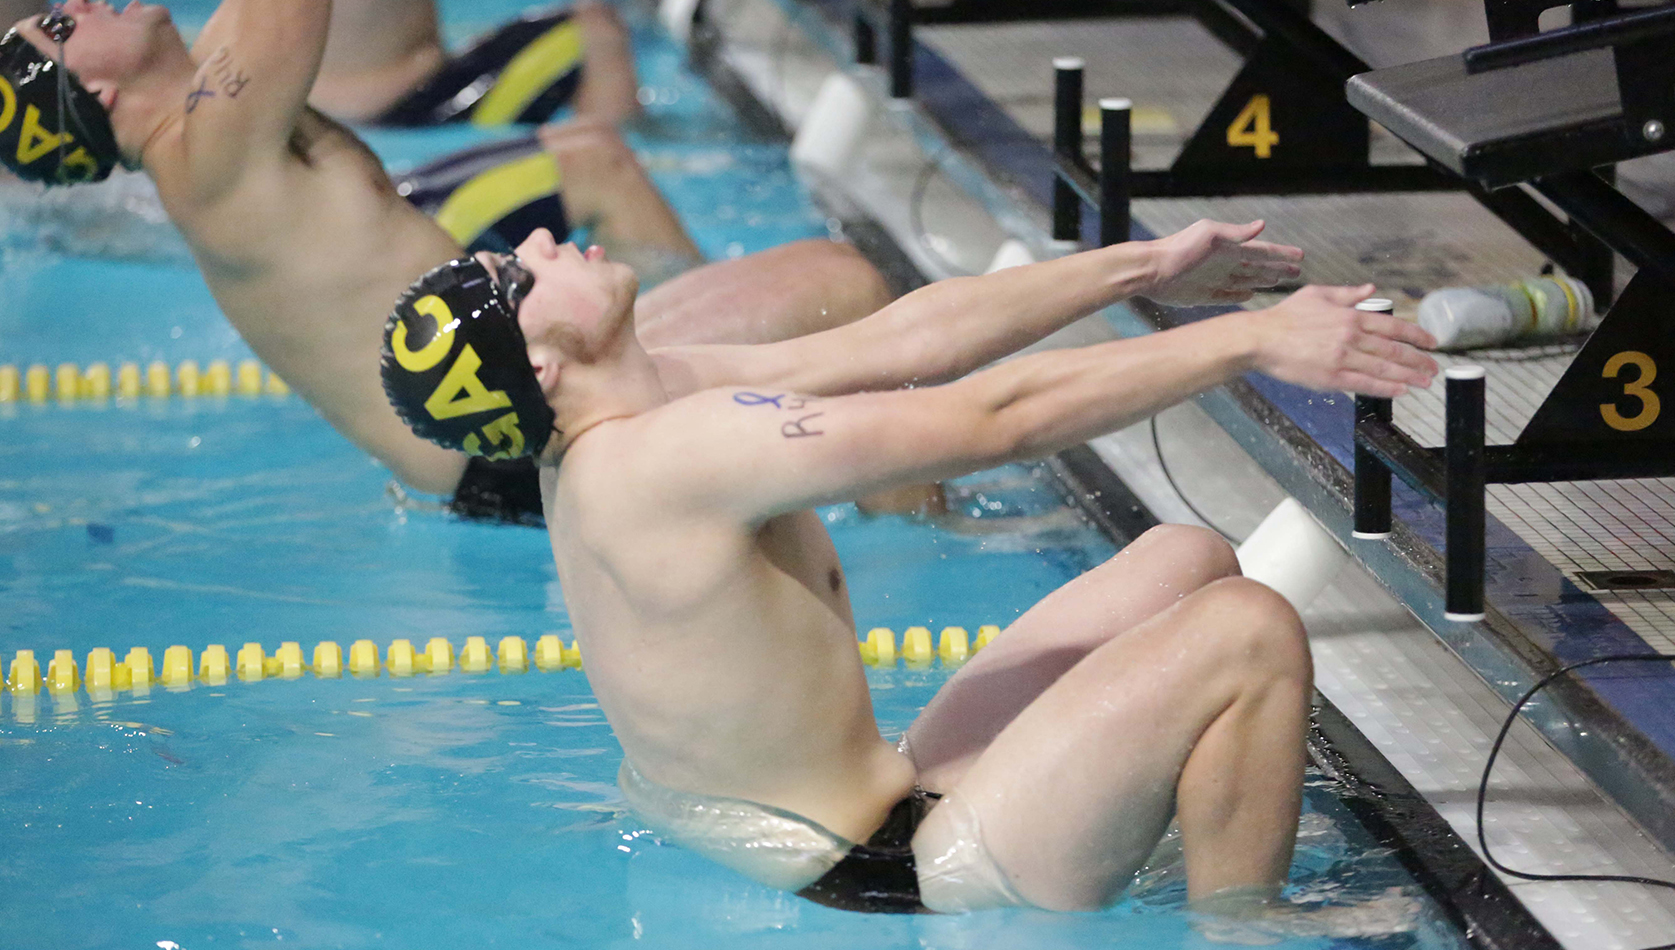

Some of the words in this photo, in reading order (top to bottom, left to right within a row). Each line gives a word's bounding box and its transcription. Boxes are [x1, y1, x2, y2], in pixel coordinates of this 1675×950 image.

[1226, 95, 1279, 158] 4
[391, 294, 525, 460] GAC
[1599, 351, 1661, 431] 3
